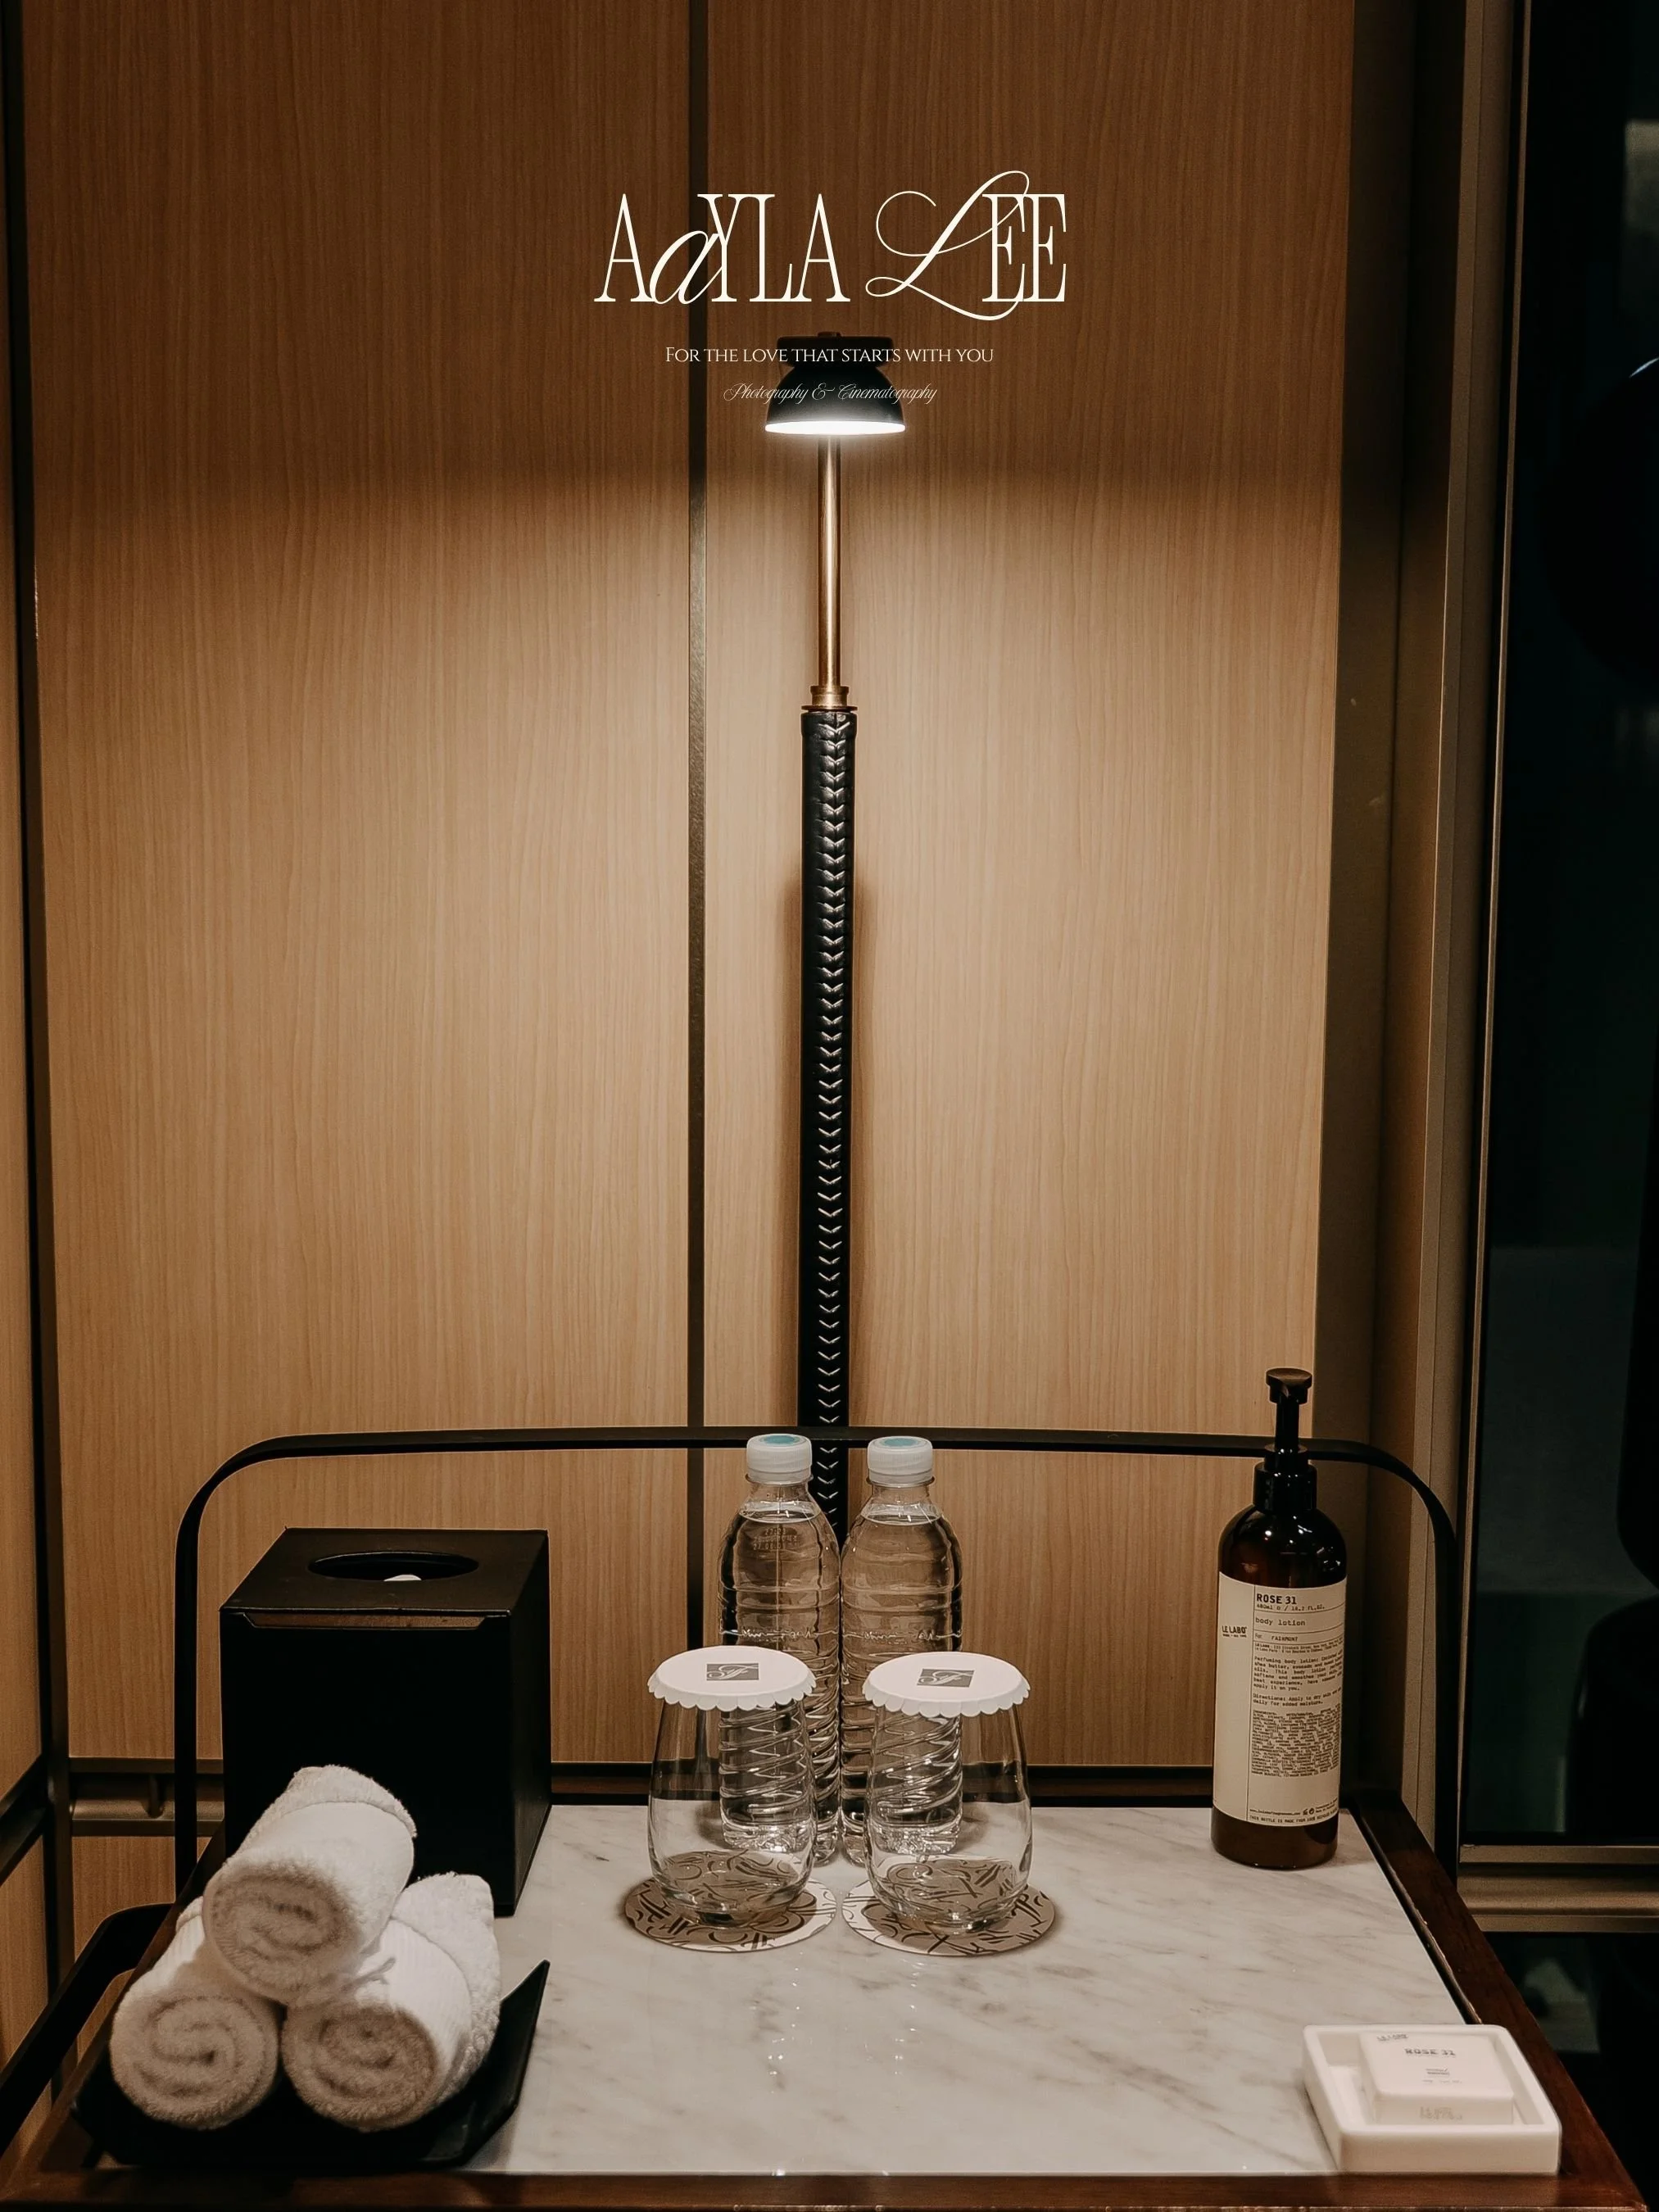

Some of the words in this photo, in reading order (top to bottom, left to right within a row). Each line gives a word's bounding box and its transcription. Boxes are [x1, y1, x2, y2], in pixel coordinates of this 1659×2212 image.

[1257, 1593, 1282, 1604] ROSE
[1285, 1596, 1297, 1605] 31
[1255, 1617, 1272, 1625] body
